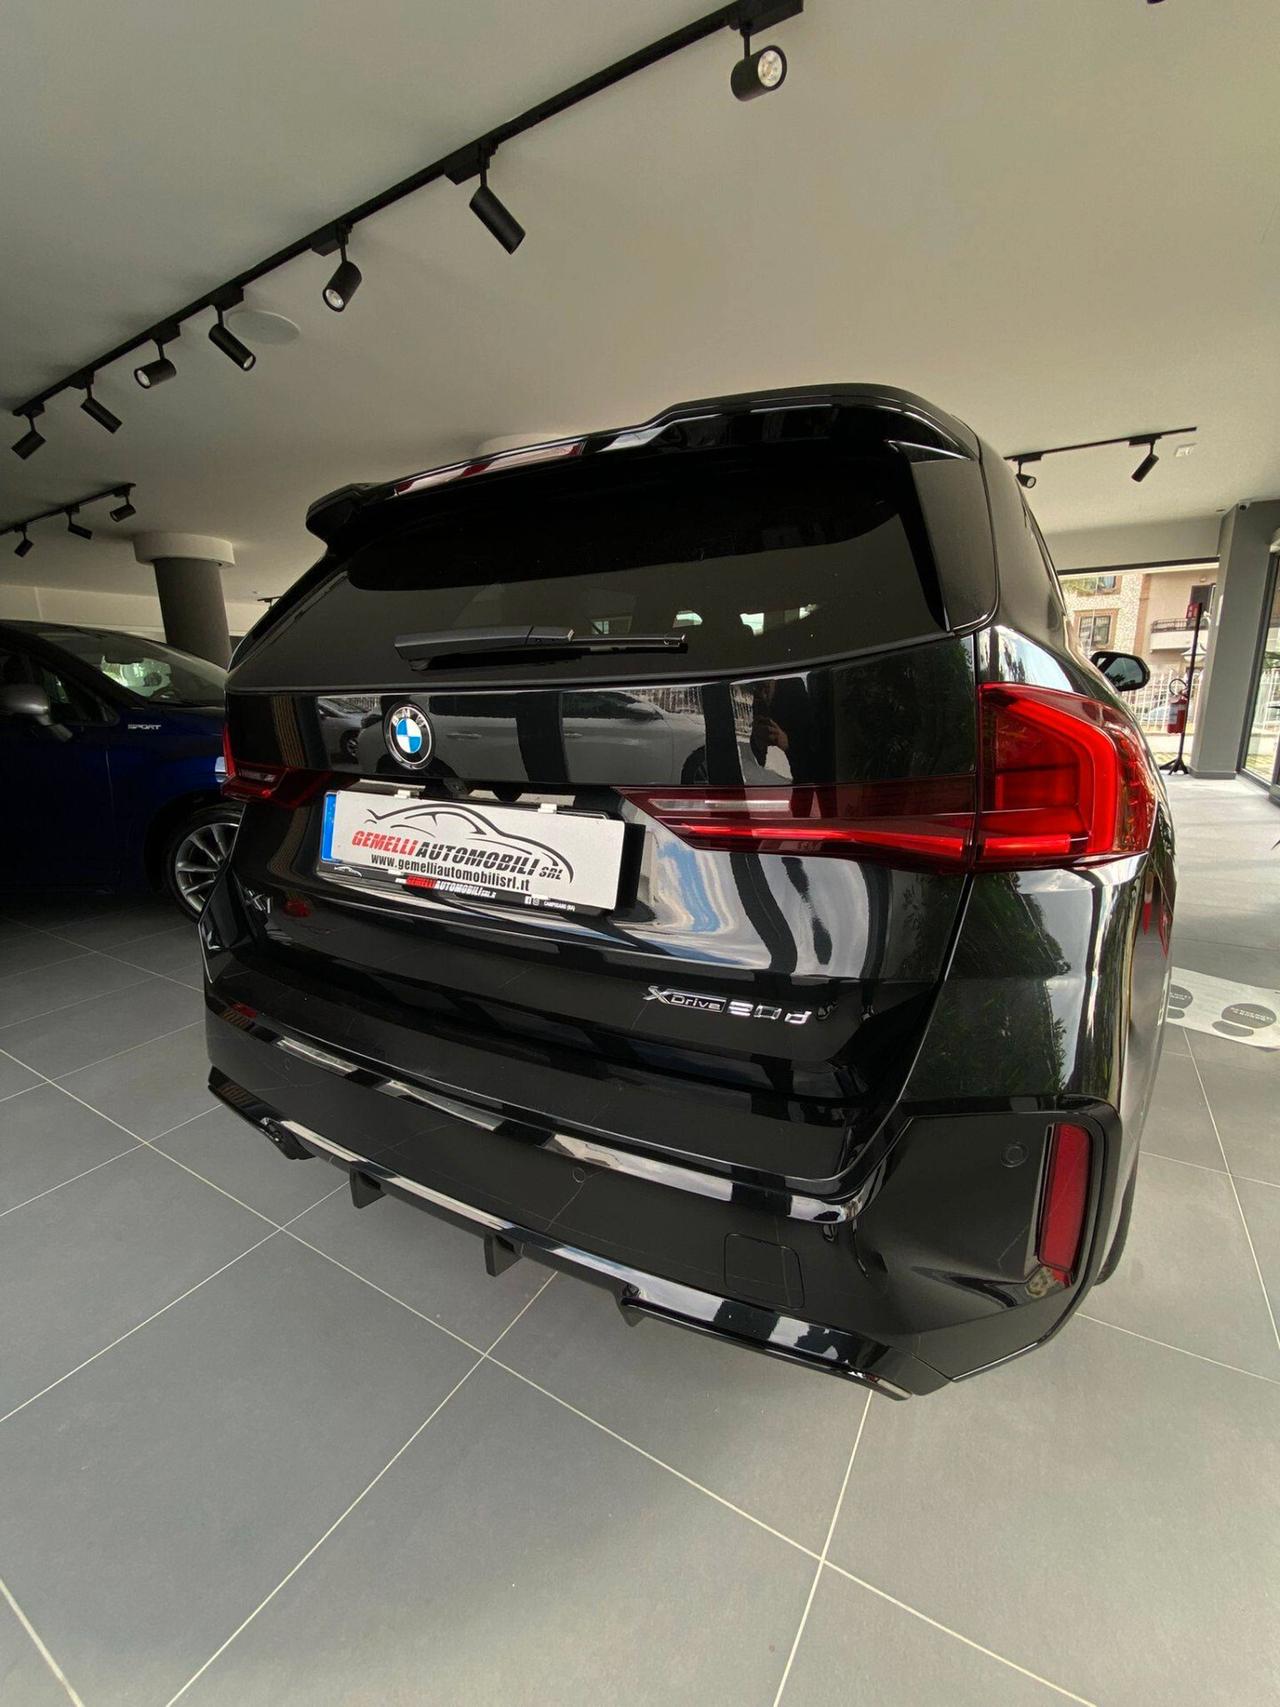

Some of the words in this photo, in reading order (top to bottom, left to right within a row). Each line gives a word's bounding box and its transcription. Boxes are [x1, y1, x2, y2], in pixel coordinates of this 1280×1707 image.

[391, 708, 426, 728] BMW
[371, 853, 530, 892] www.gemelliautomobilisrl.it
[538, 866, 564, 880] SRL
